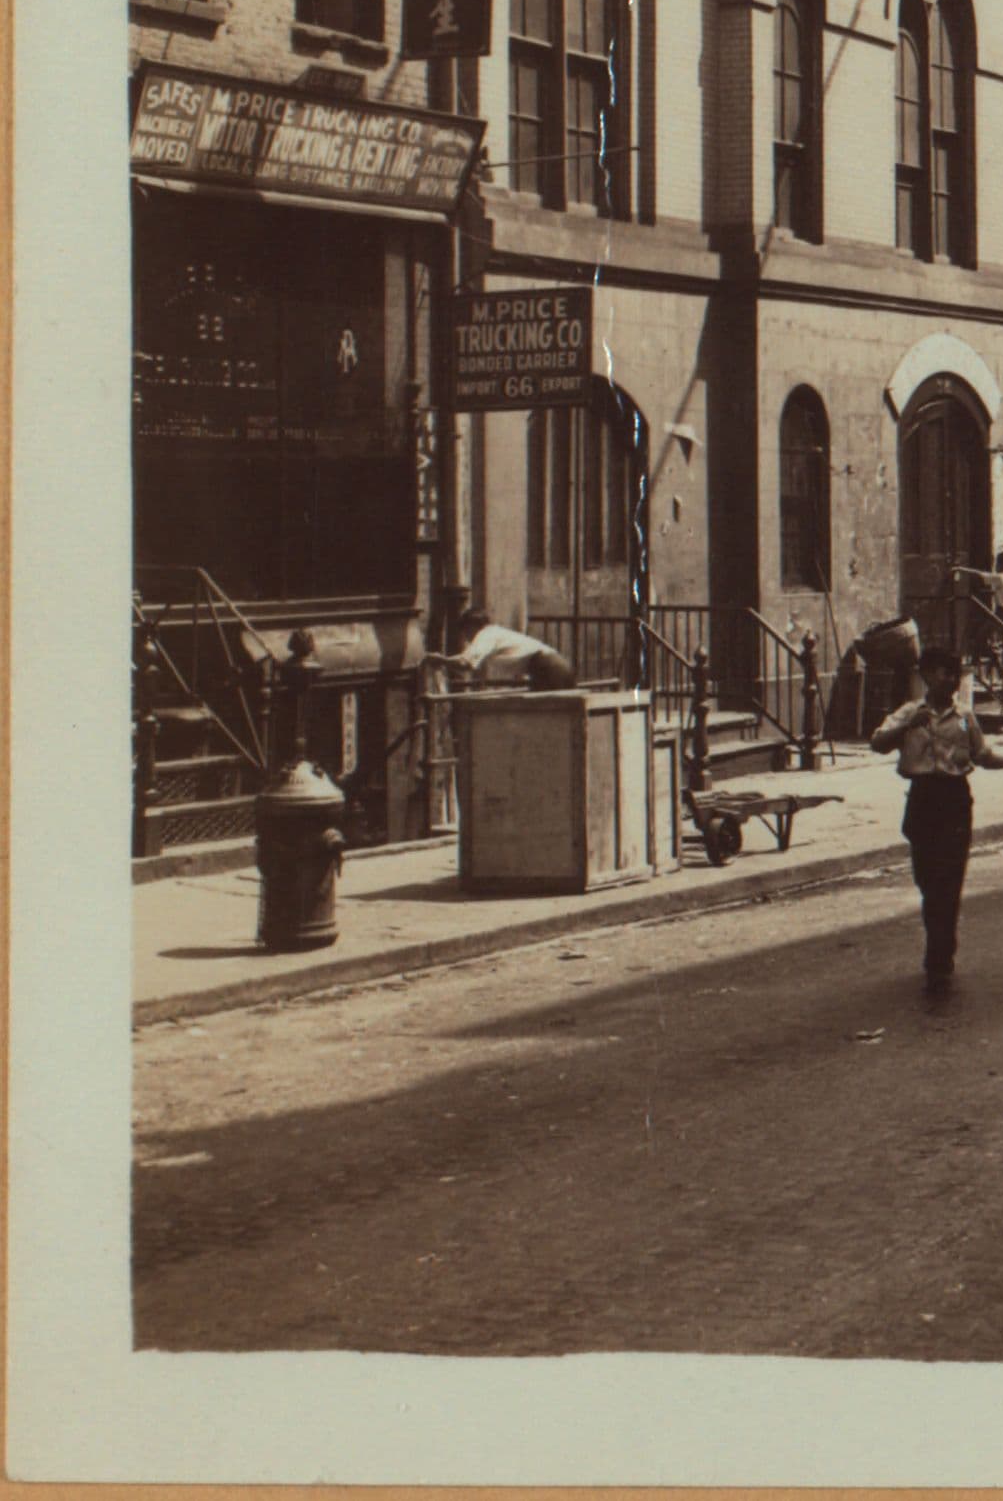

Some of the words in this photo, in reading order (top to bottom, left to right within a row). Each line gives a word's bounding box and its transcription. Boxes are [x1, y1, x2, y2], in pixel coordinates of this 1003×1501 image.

[146, 81, 201, 116] SAFES
[302, 102, 396, 139] TRUCKING
[130, 133, 189, 164] MOVED
[197, 112, 258, 155] MOTOR
[261, 123, 342, 169] TRUCKING
[351, 138, 421, 181] RENTING
[201, 152, 240, 174] LOCAL
[290, 166, 351, 189] DISTANCE
[352, 175, 406, 194] HAULING
[456, 322, 553, 353] TRUCKING
[459, 356, 512, 373] BONDED
[516, 351, 577, 371] CARRIER
[457, 380, 497, 396] IMPORT
[504, 375, 533, 397] 66
[541, 376, 582, 392] EXPORT
